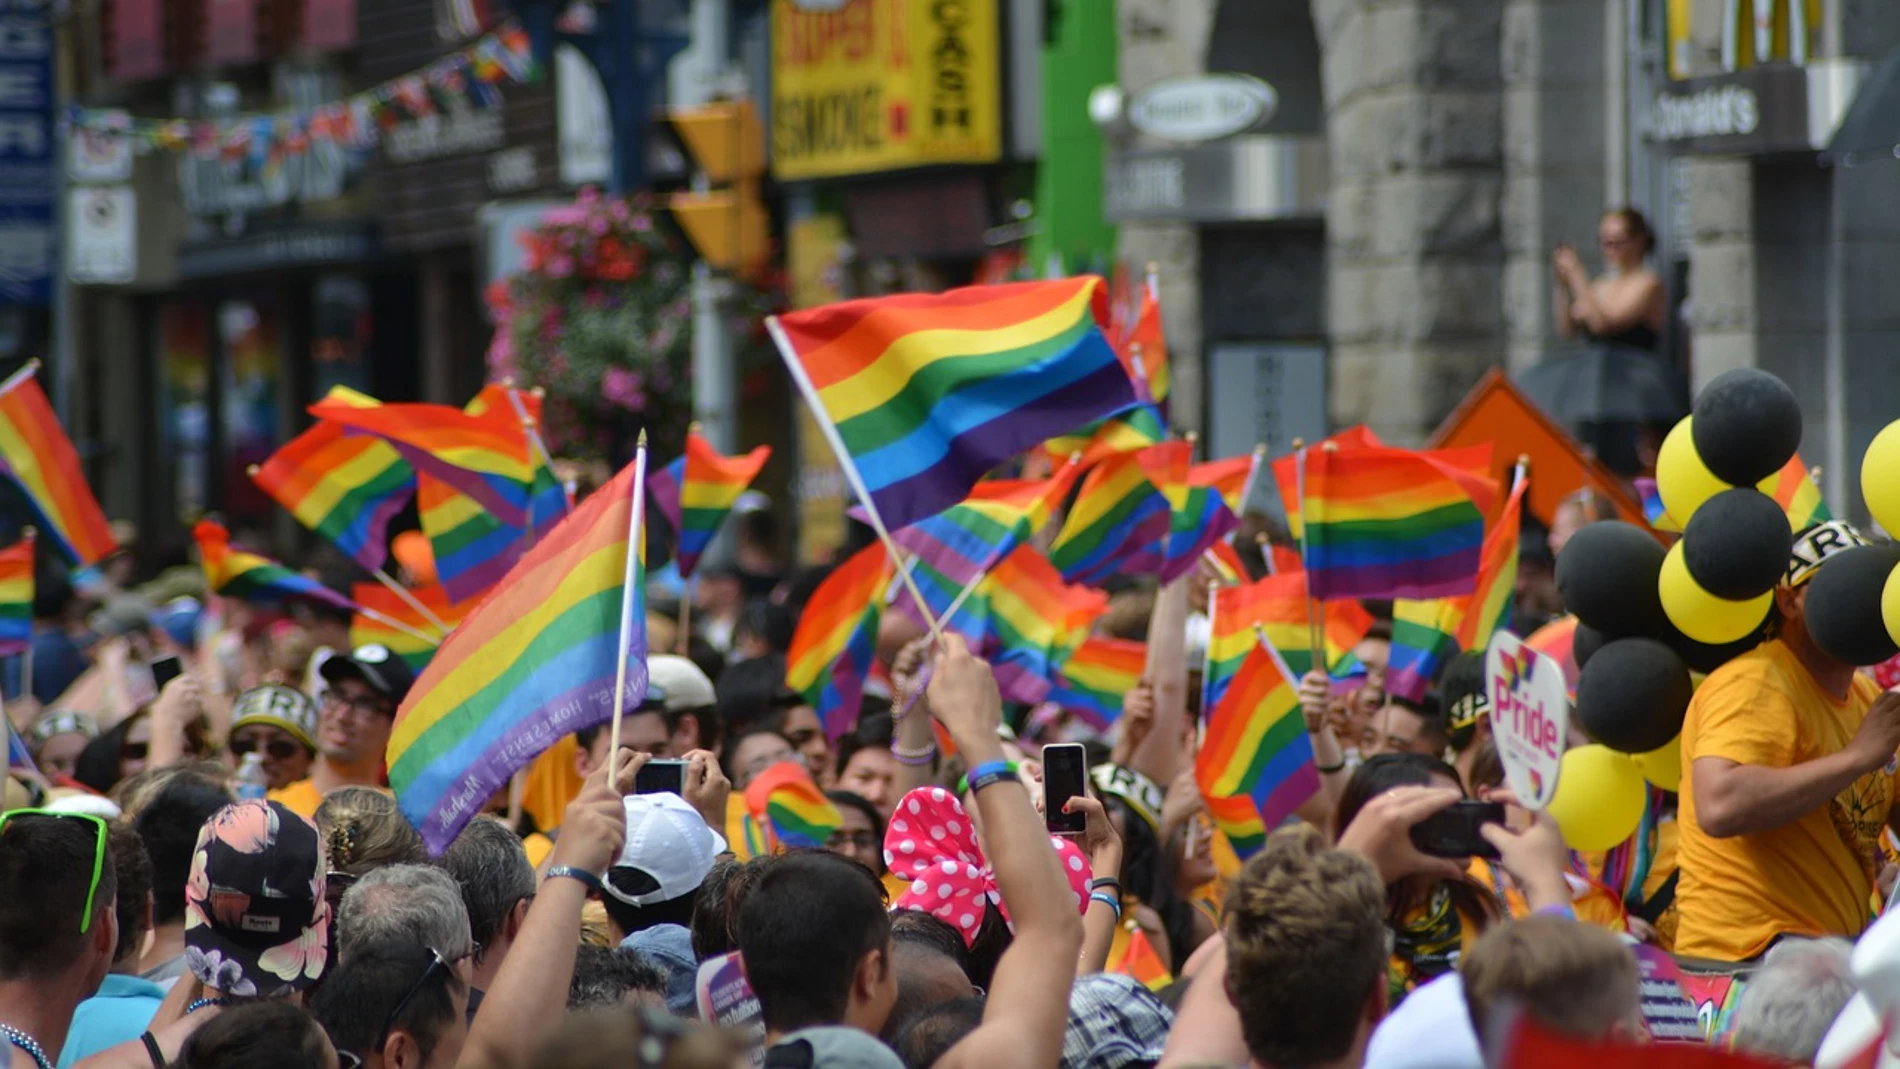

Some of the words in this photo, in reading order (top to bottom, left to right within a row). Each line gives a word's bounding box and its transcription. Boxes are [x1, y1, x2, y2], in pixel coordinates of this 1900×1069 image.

[929, 0, 971, 130] CASH
[768, 85, 882, 157] SMOKE
[1494, 673, 1558, 760] Pride
